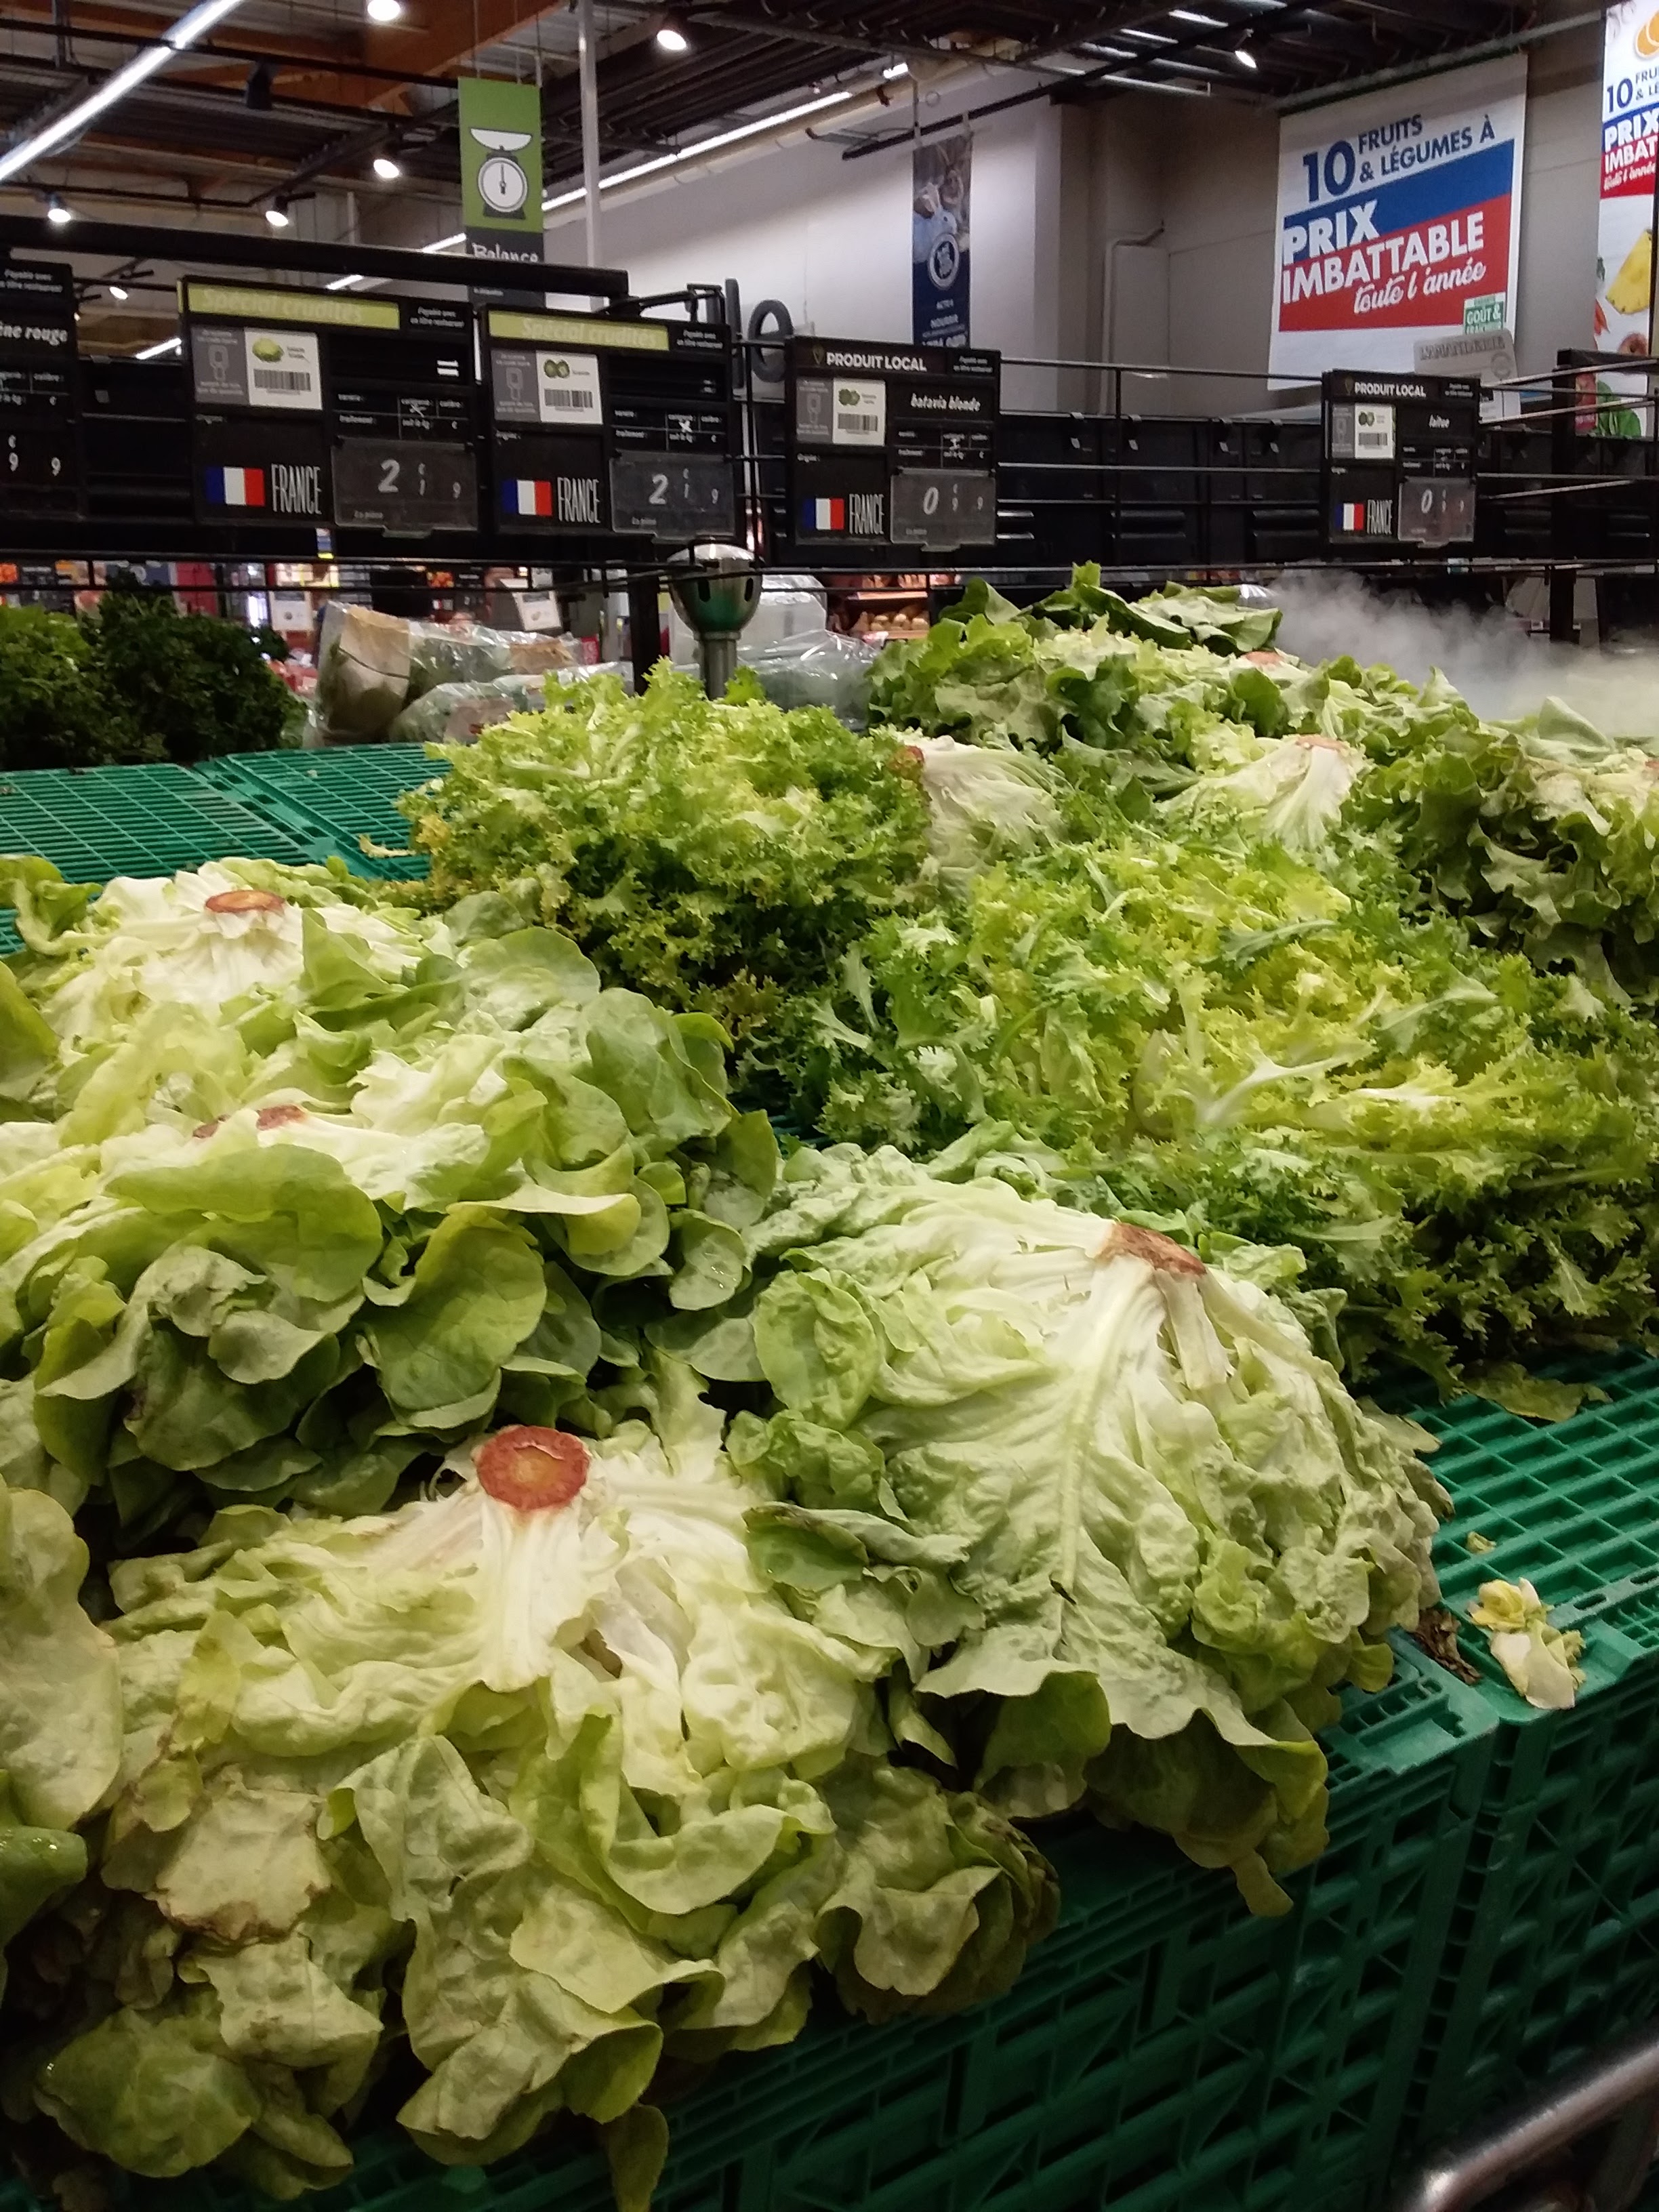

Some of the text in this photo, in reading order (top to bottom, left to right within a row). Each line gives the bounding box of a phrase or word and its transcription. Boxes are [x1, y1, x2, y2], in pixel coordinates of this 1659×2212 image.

[1607, 77, 1633, 112] 10
[1635, 88, 1643, 100] &
[1359, 114, 1423, 155] FRUITS
[1604, 107, 1658, 153] PRIX
[1359, 114, 1496, 183] & LÉGUMES À
[1303, 140, 1356, 202] 10
[1283, 199, 1380, 267] PRIX
[1282, 211, 1484, 304] IMBATTABLE
[1353, 275, 1406, 314] toute
[25, 327, 68, 346] rouge
[826, 351, 928, 373] PRODUIT LOCAL
[1354, 381, 1395, 397] PRODUIT
[1396, 383, 1427, 398] LOCAL
[9, 452, 19, 472] 9
[51, 457, 61, 476] 9
[377, 459, 401, 494] 2
[271, 464, 323, 515] FRANCE
[557, 477, 601, 525] FRANCE
[649, 474, 670, 505] 2
[923, 487, 939, 515] 0
[1421, 489, 1433, 514] 0
[848, 493, 885, 535] FRANCE
[1366, 499, 1393, 535] FRANCE
